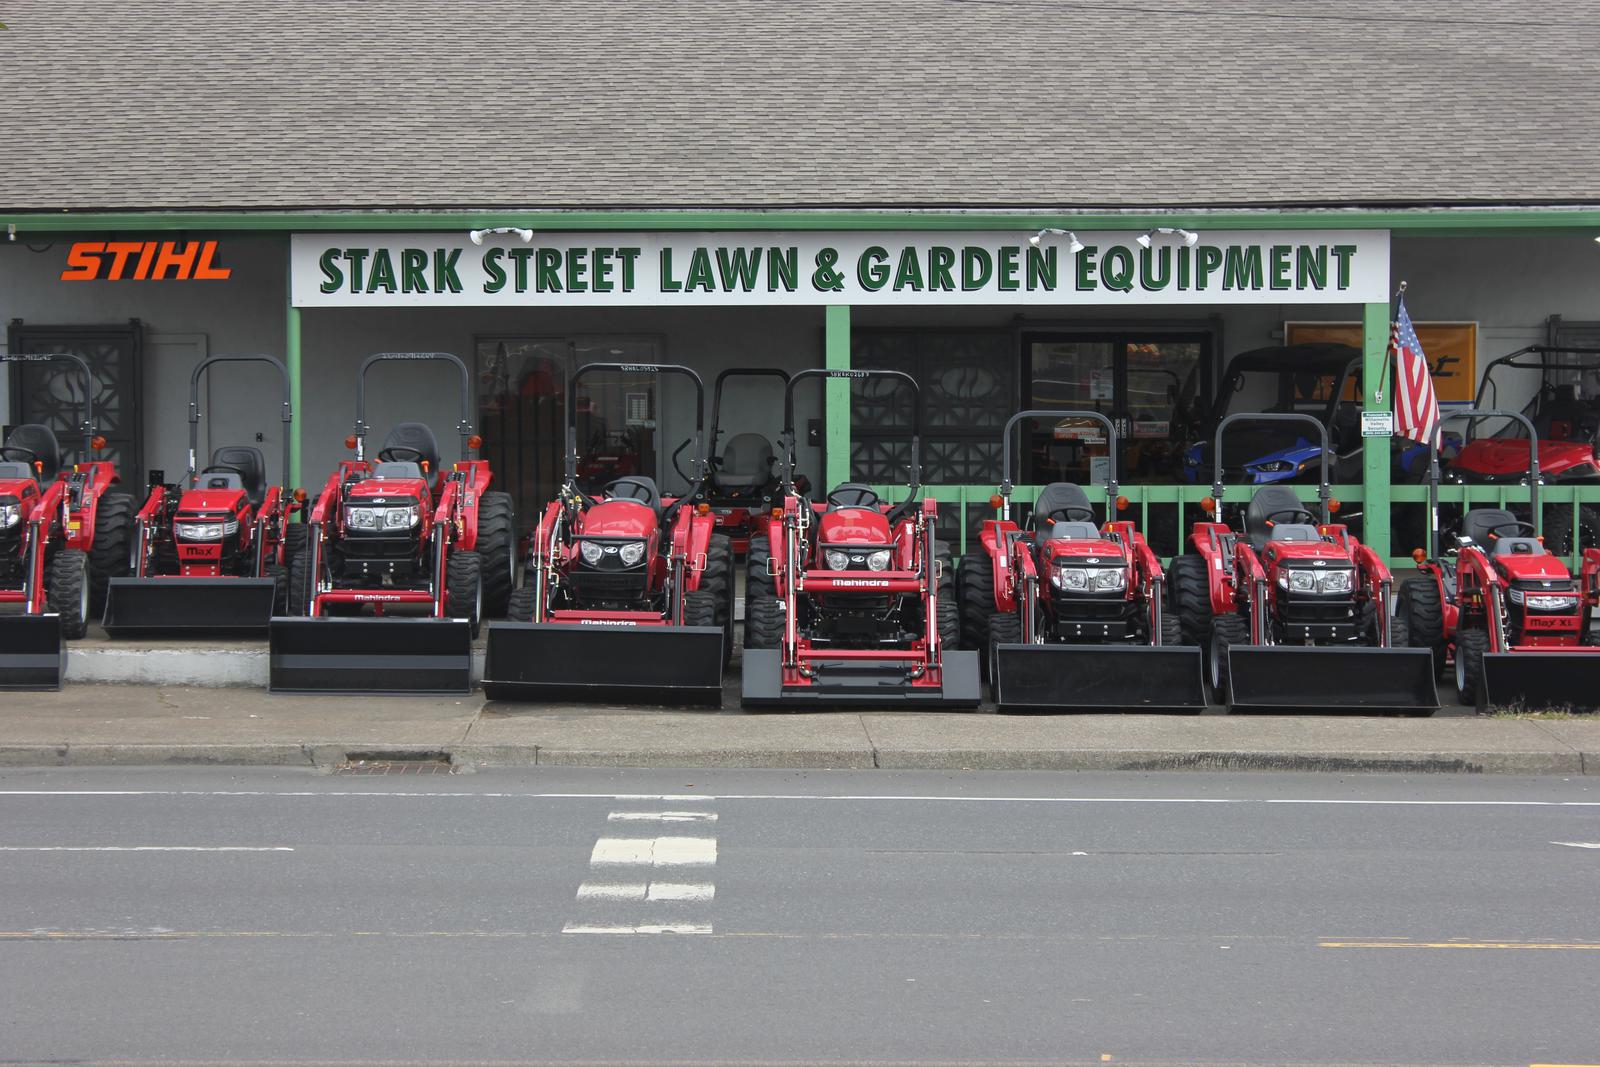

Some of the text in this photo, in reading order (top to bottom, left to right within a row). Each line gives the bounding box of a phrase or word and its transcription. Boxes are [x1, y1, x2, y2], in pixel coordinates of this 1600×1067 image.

[61, 241, 231, 281] STIHL
[319, 245, 1358, 294] STARK STREET LAWN & GARDEN EQUIPMENT
